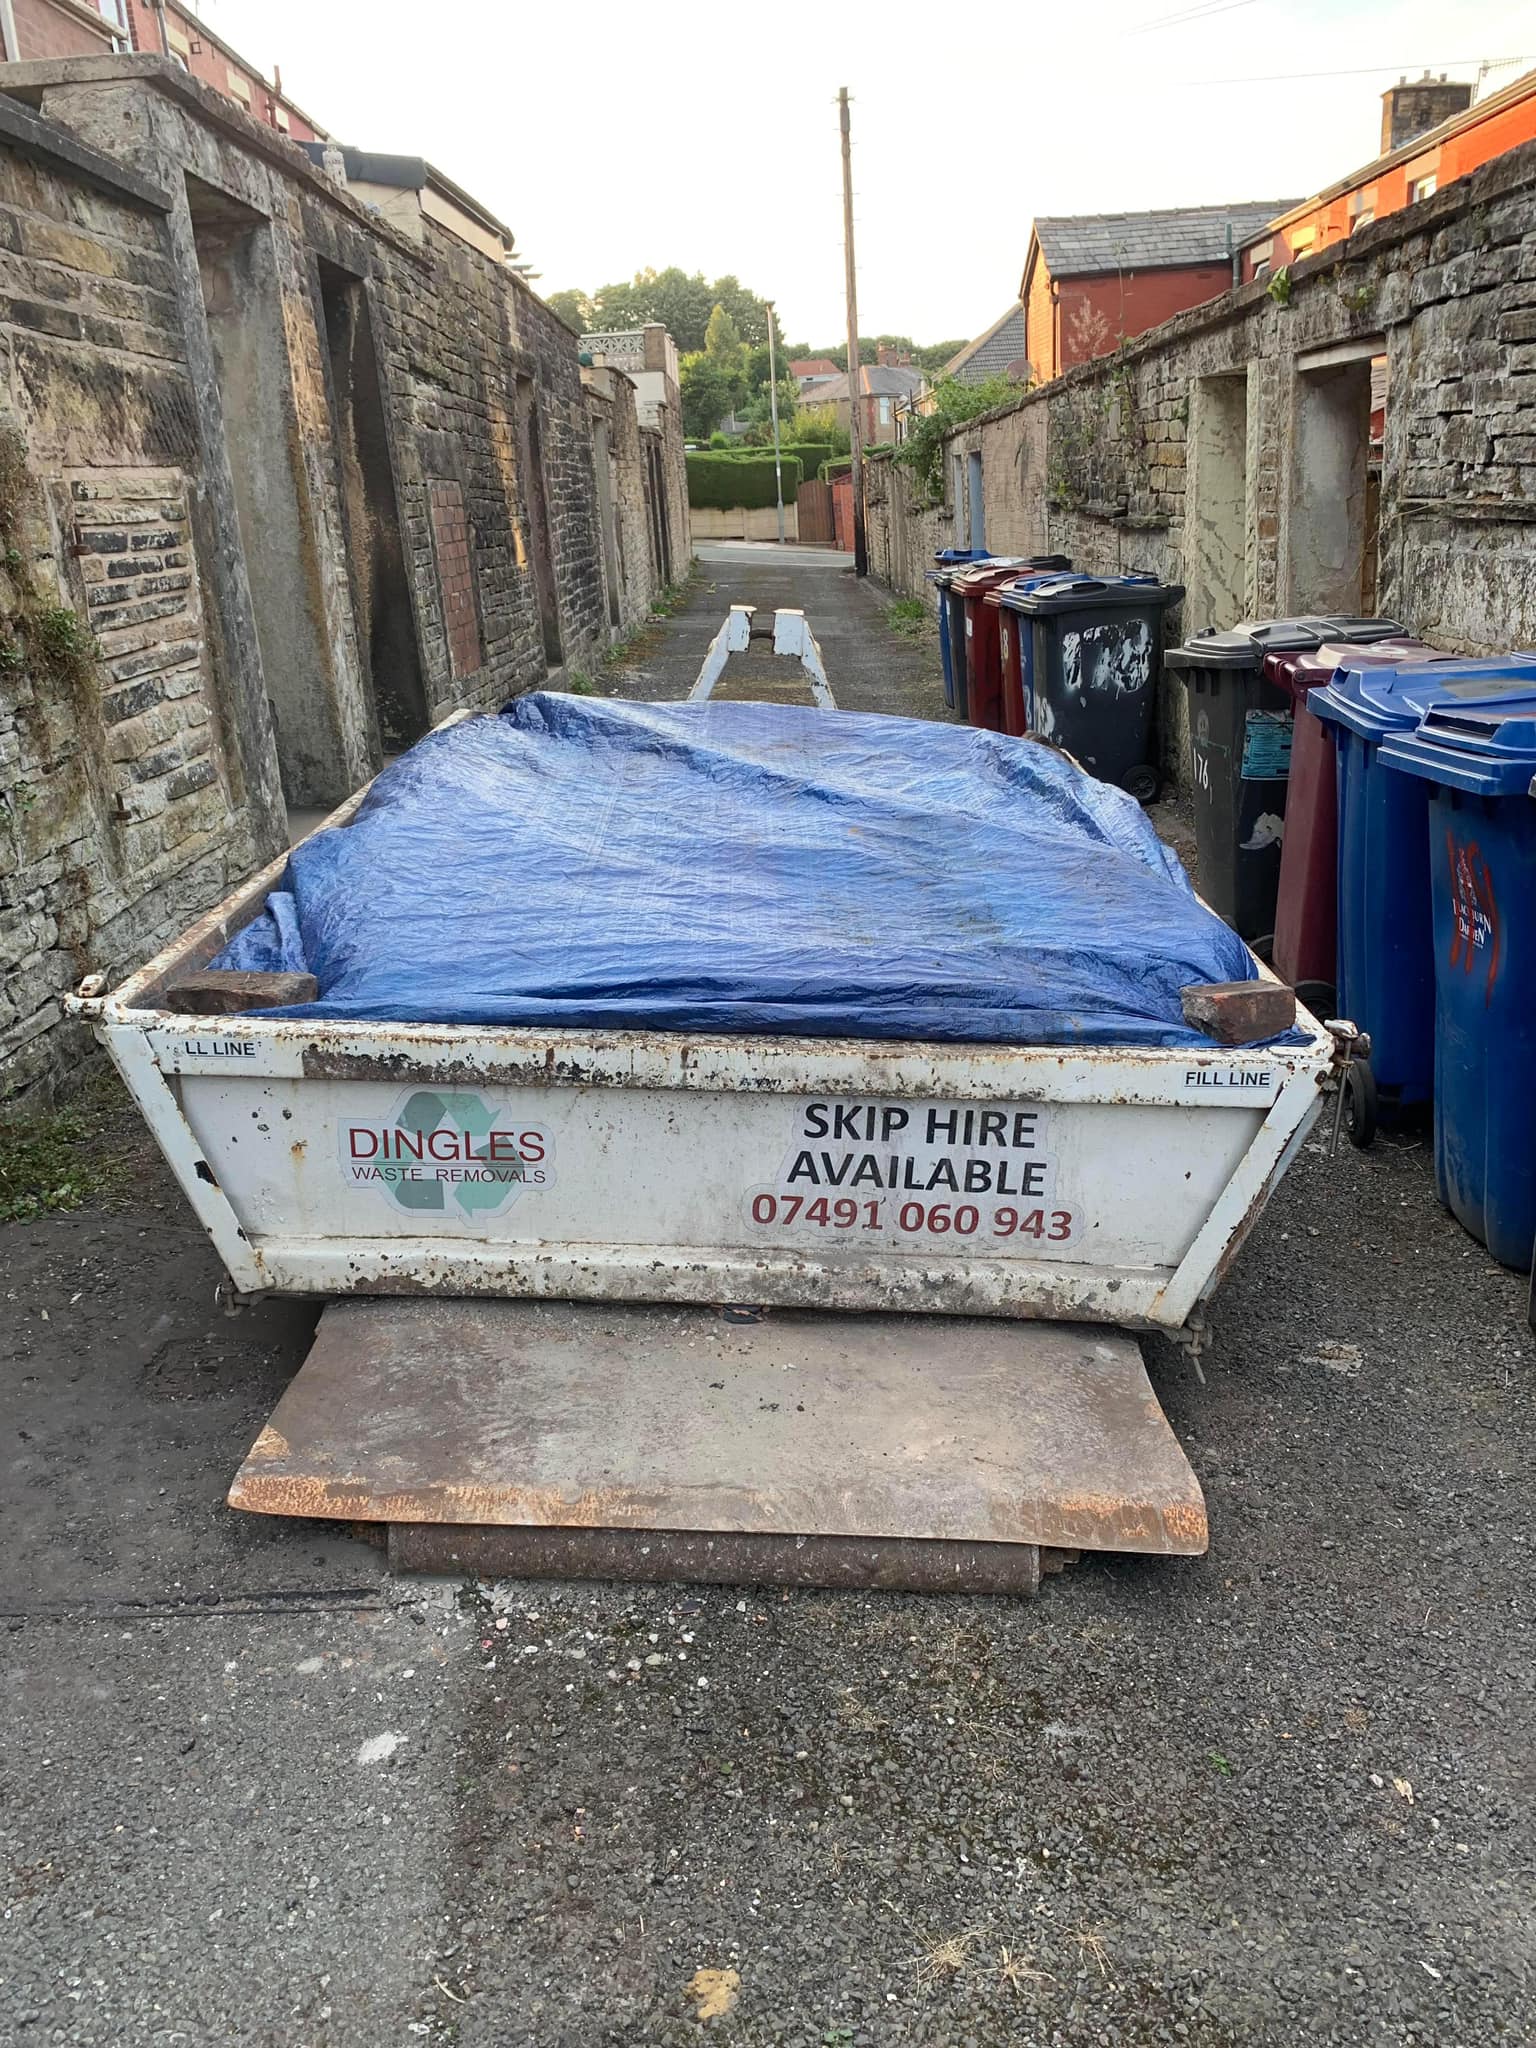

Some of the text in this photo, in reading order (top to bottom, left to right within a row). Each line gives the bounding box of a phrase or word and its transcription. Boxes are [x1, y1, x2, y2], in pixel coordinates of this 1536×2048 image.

[1193, 747, 1209, 790] 176
[213, 1042, 256, 1056] LINE
[1186, 1071, 1271, 1086] FILL LINE
[349, 1128, 546, 1162] DINGLES
[803, 1103, 1039, 1149] SKIP HIRE
[352, 1167, 546, 1184] WASTE REMOVALS
[786, 1150, 1048, 1197] AVAILABLE
[752, 1194, 1073, 1241] 07491 060 943
